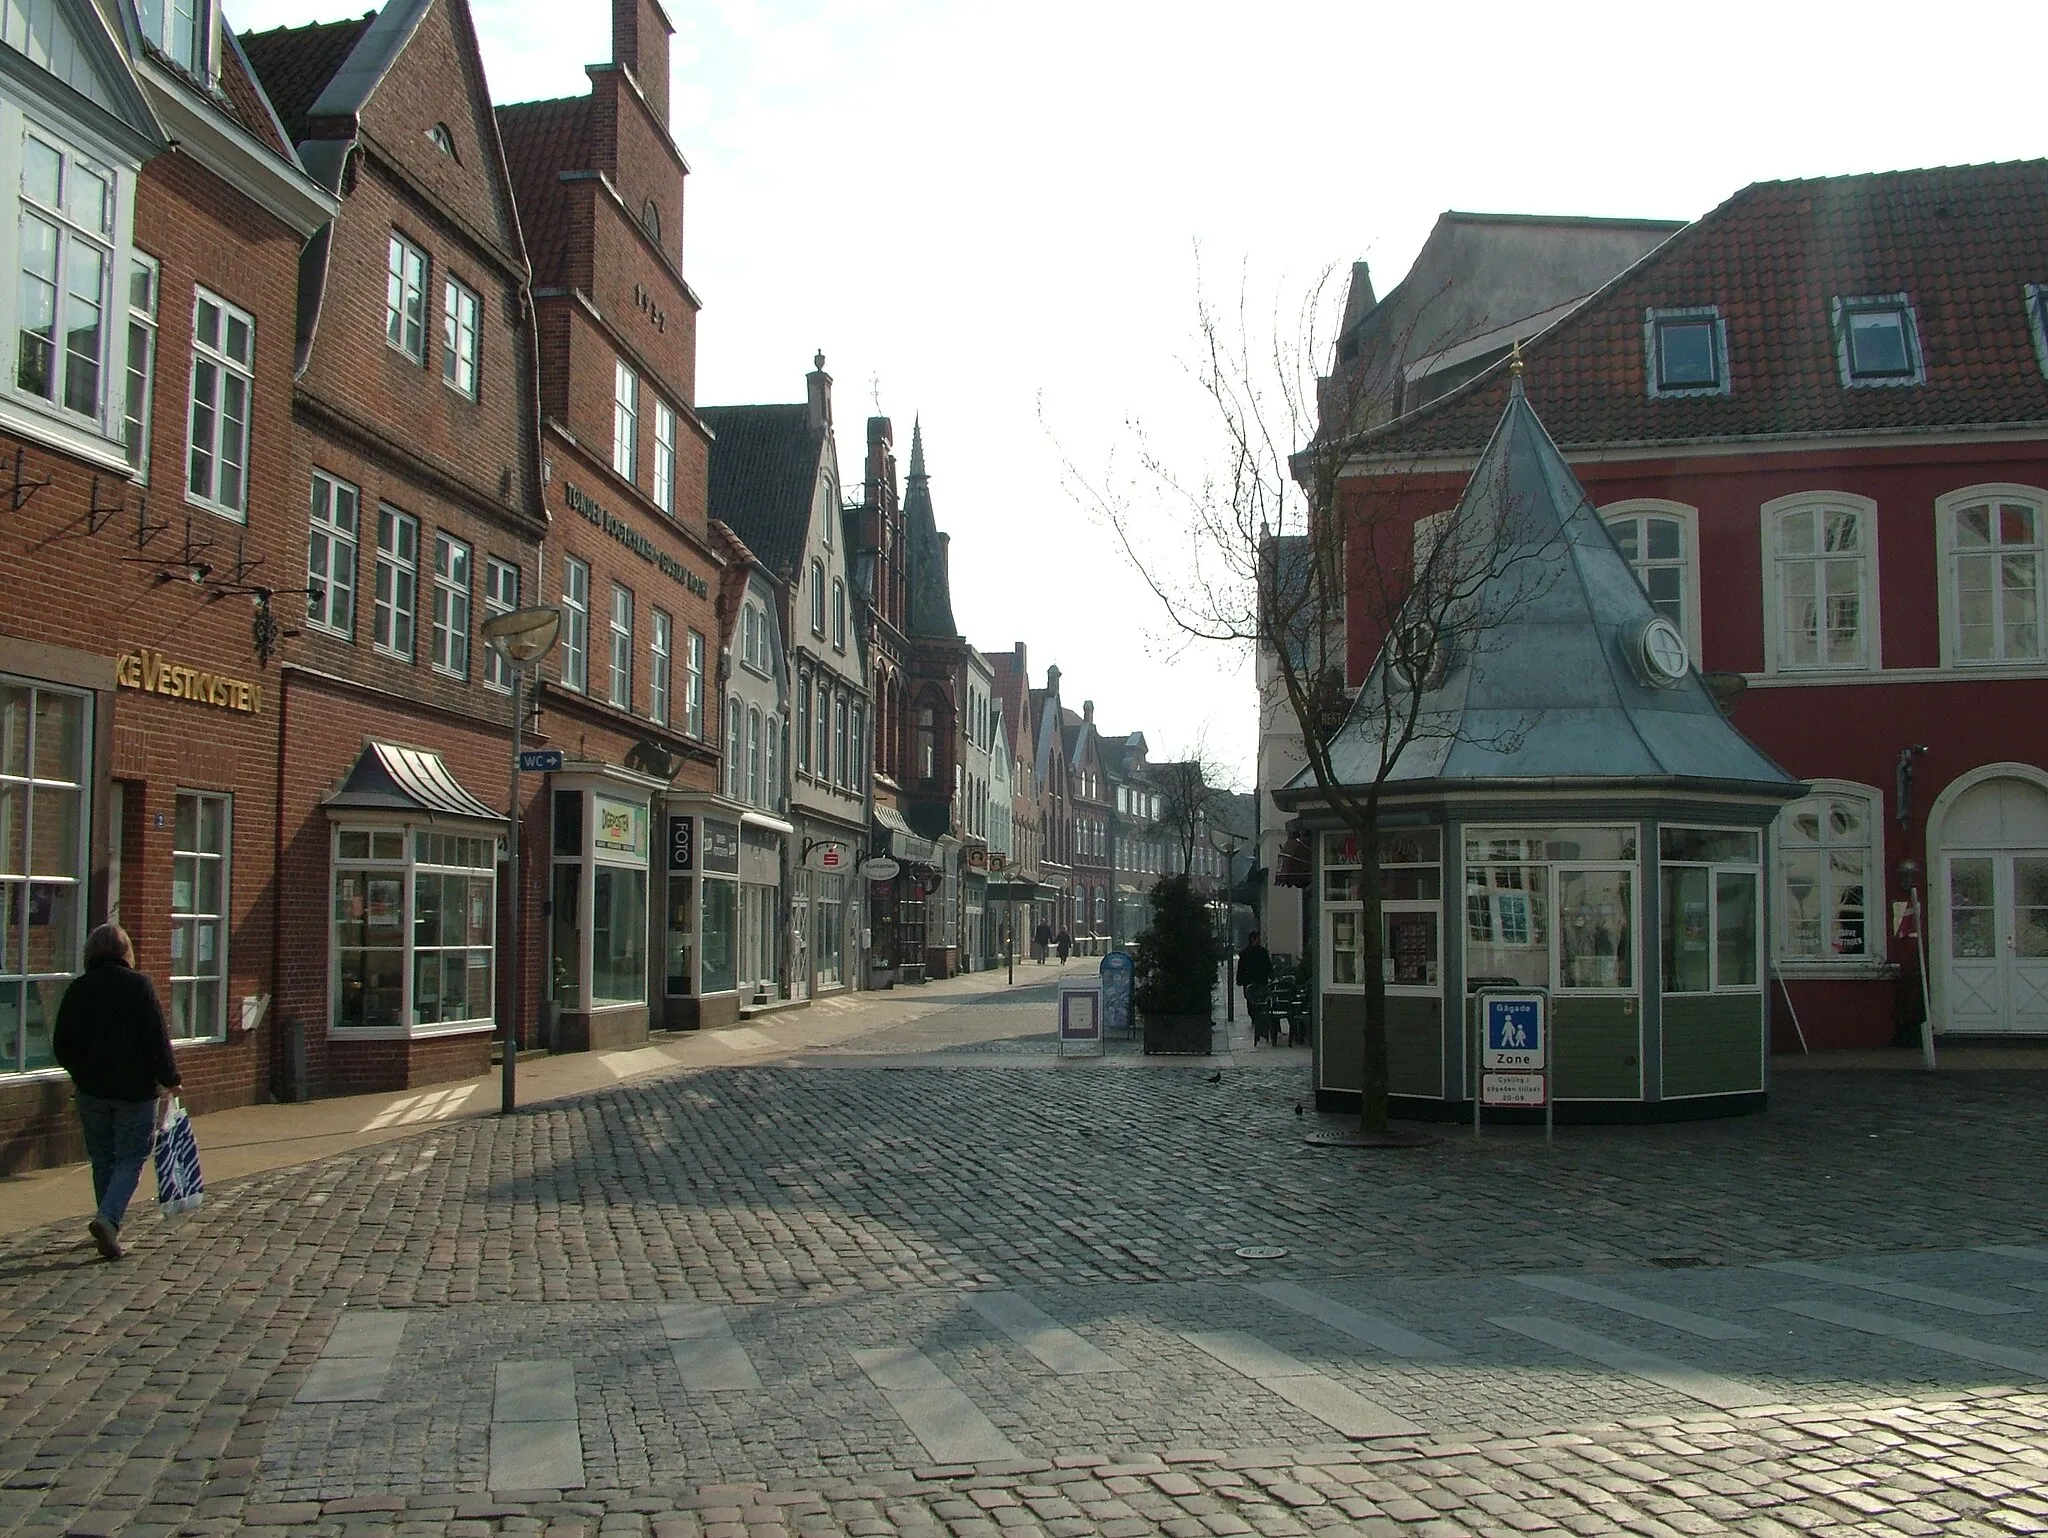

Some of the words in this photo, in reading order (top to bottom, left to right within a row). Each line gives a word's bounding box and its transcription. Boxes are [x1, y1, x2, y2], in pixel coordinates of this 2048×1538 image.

[523, 756, 544, 767] WC
[675, 823, 689, 863] FOTO
[1496, 1004, 1531, 1014] Gågade
[1496, 1053, 1531, 1065] Zone
[1497, 1076, 1524, 1084] Cykling
